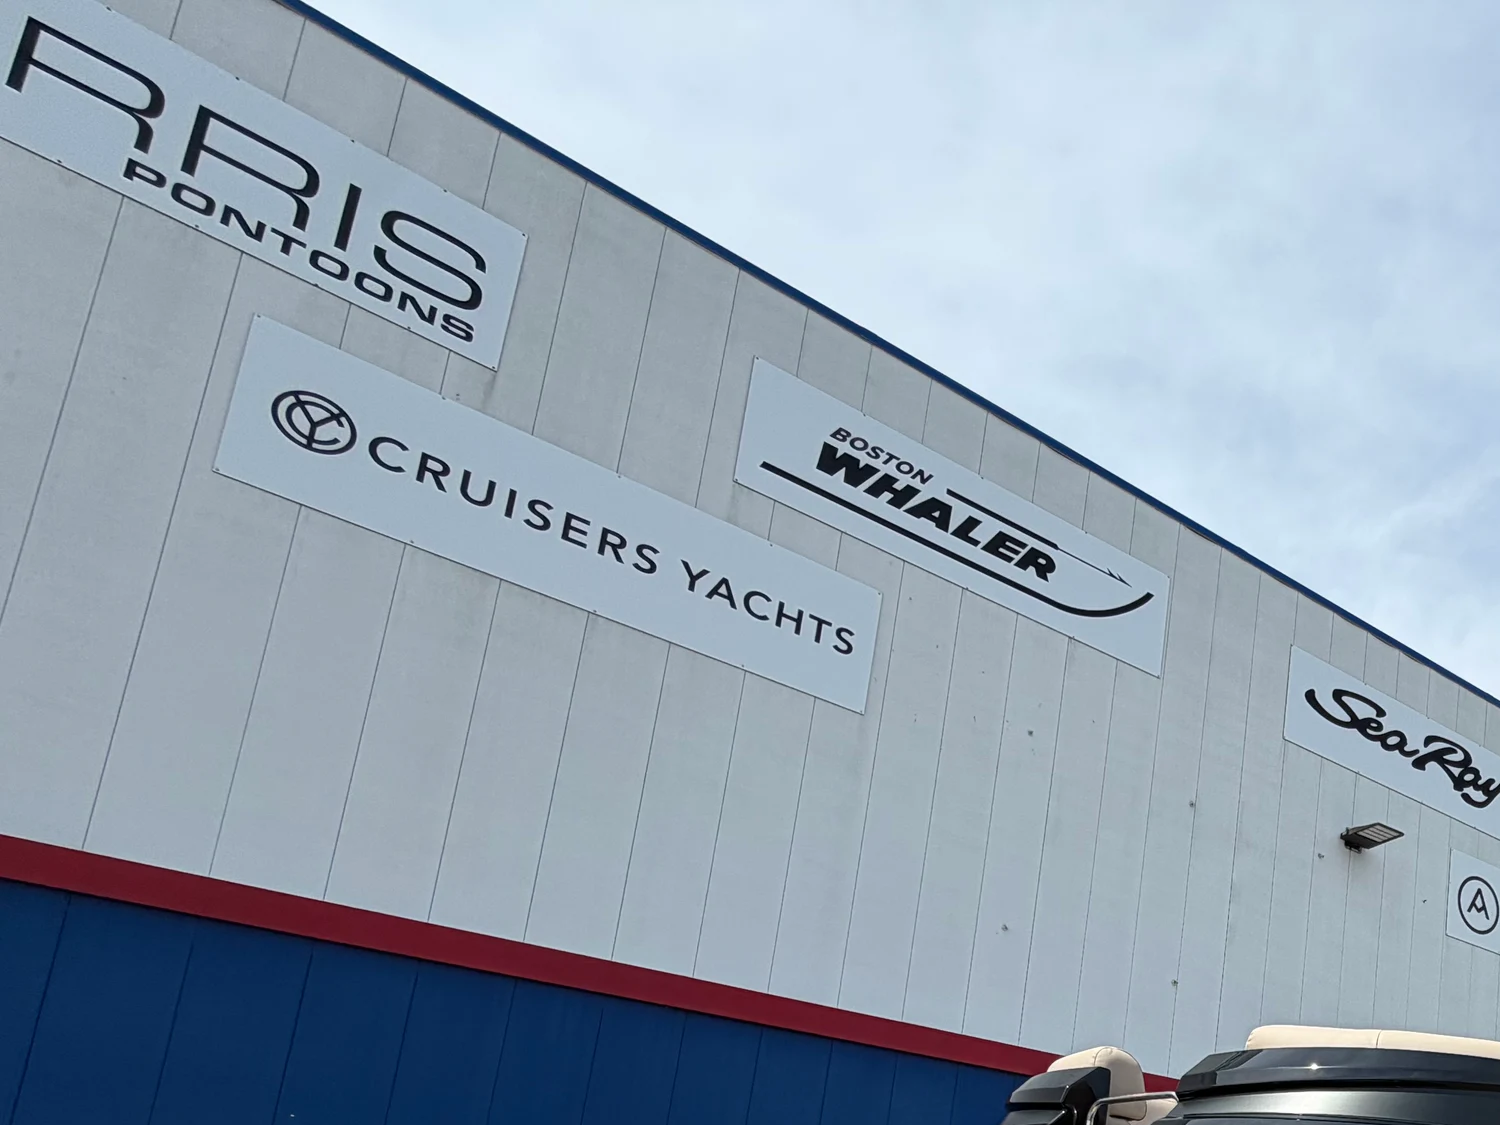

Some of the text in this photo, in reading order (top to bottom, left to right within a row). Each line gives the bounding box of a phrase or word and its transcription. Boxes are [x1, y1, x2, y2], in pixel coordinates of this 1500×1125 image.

[6, 16, 487, 311] RRIS
[122, 157, 475, 343] PONTOONS
[815, 441, 1057, 583] WHALER
[824, 427, 934, 485] BOSTON
[368, 436, 855, 655] CRUISERS YACHTS
[1304, 688, 1419, 758] Sea
